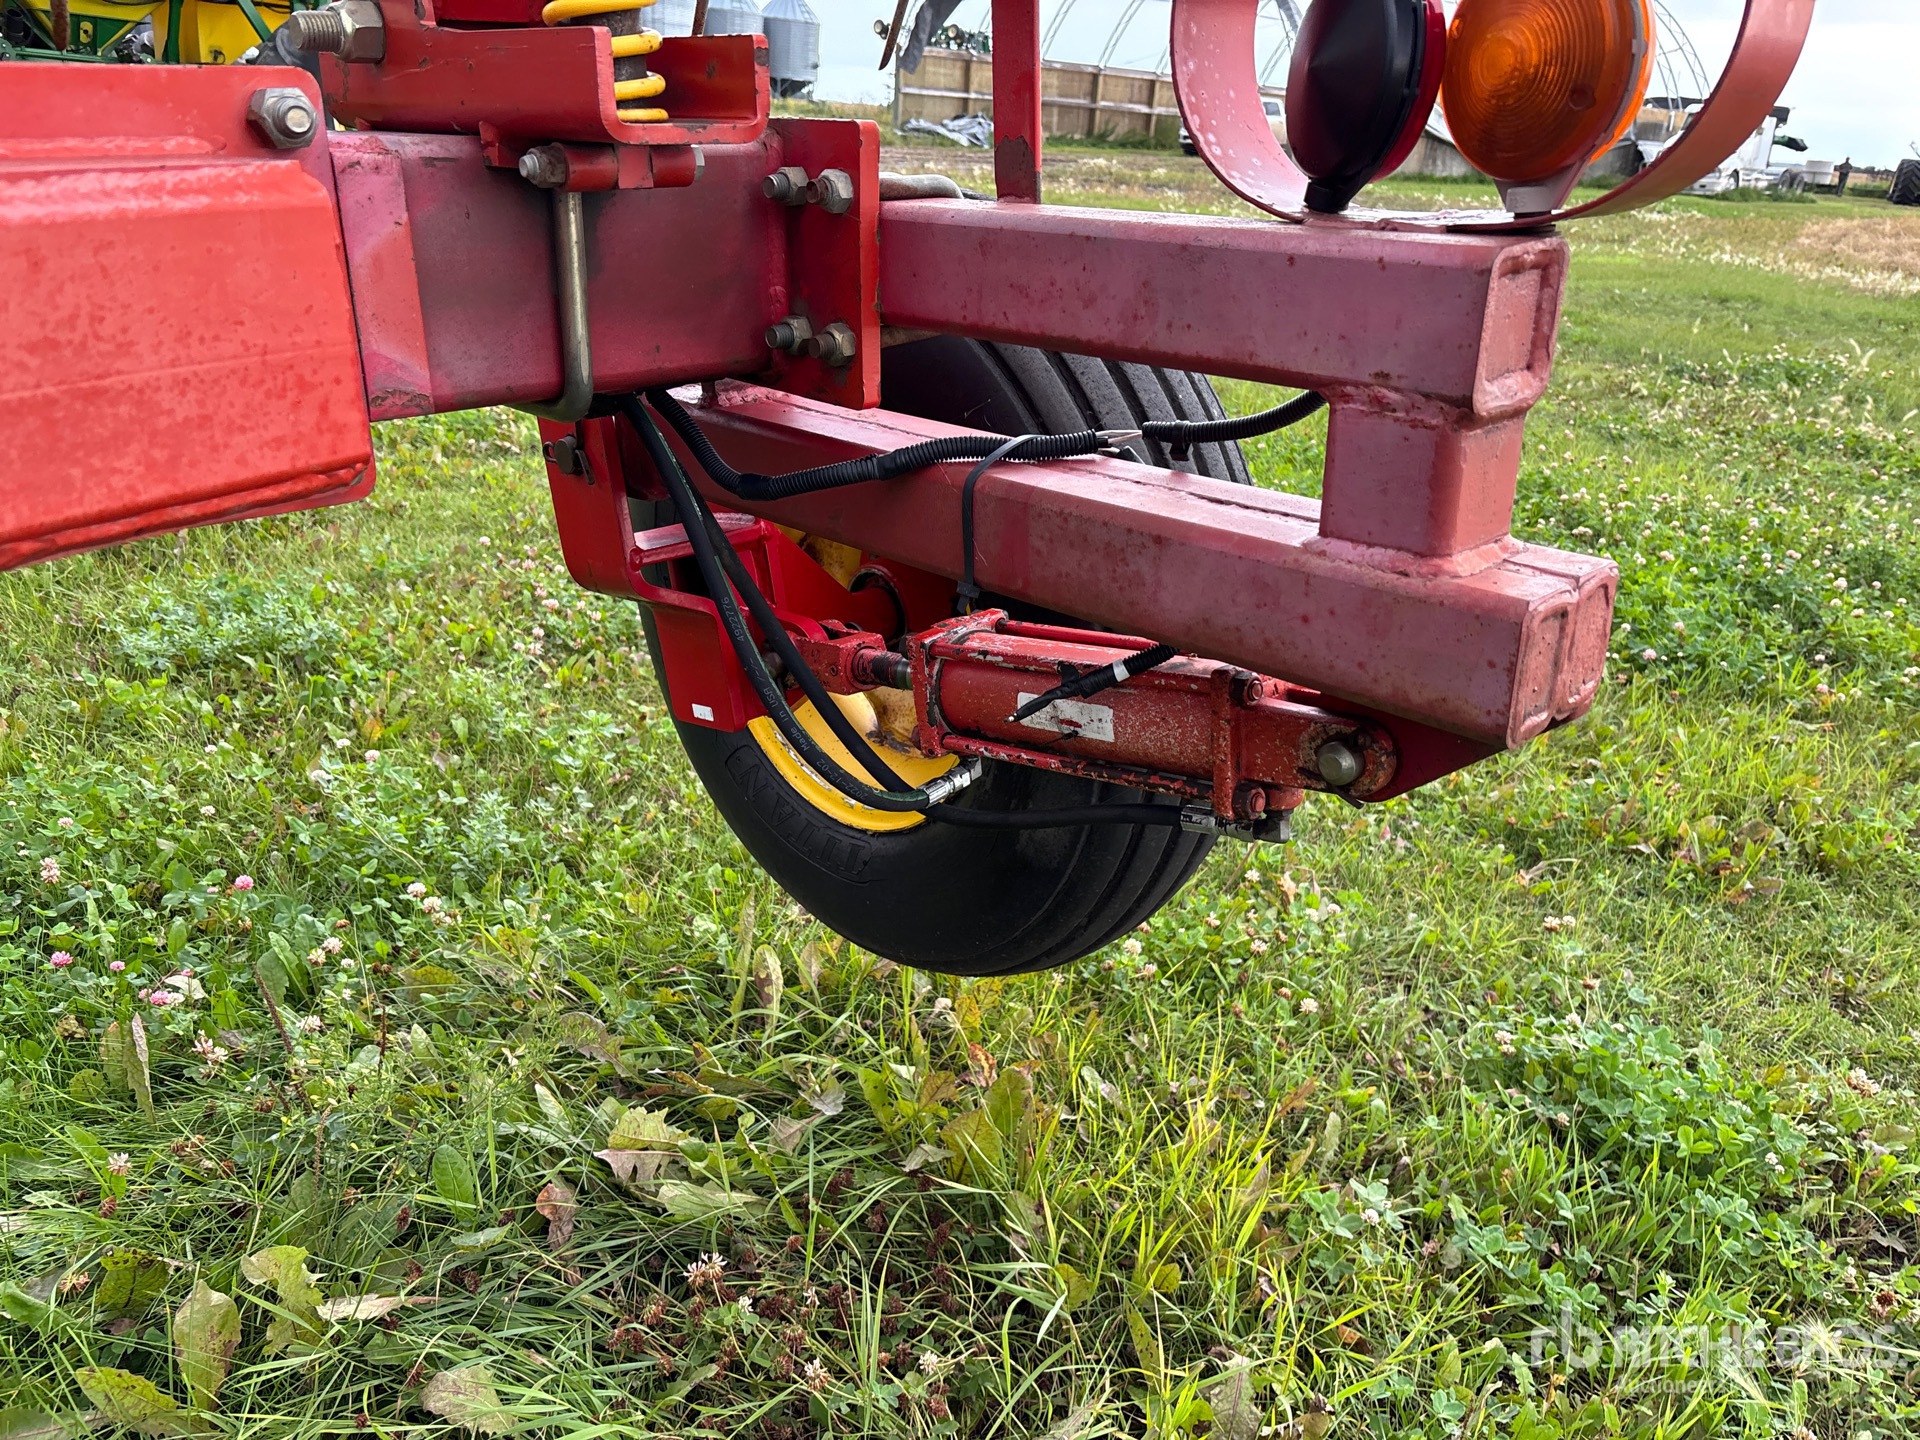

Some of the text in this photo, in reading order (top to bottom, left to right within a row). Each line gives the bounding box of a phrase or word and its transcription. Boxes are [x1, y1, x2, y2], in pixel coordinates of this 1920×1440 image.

[721, 596, 745, 642] 4922776
[763, 687, 778, 708] USA
[779, 711, 789, 722] in
[790, 727, 810, 752] Made
[816, 759, 868, 800] 2022-12-02
[734, 762, 868, 875] TITAN
